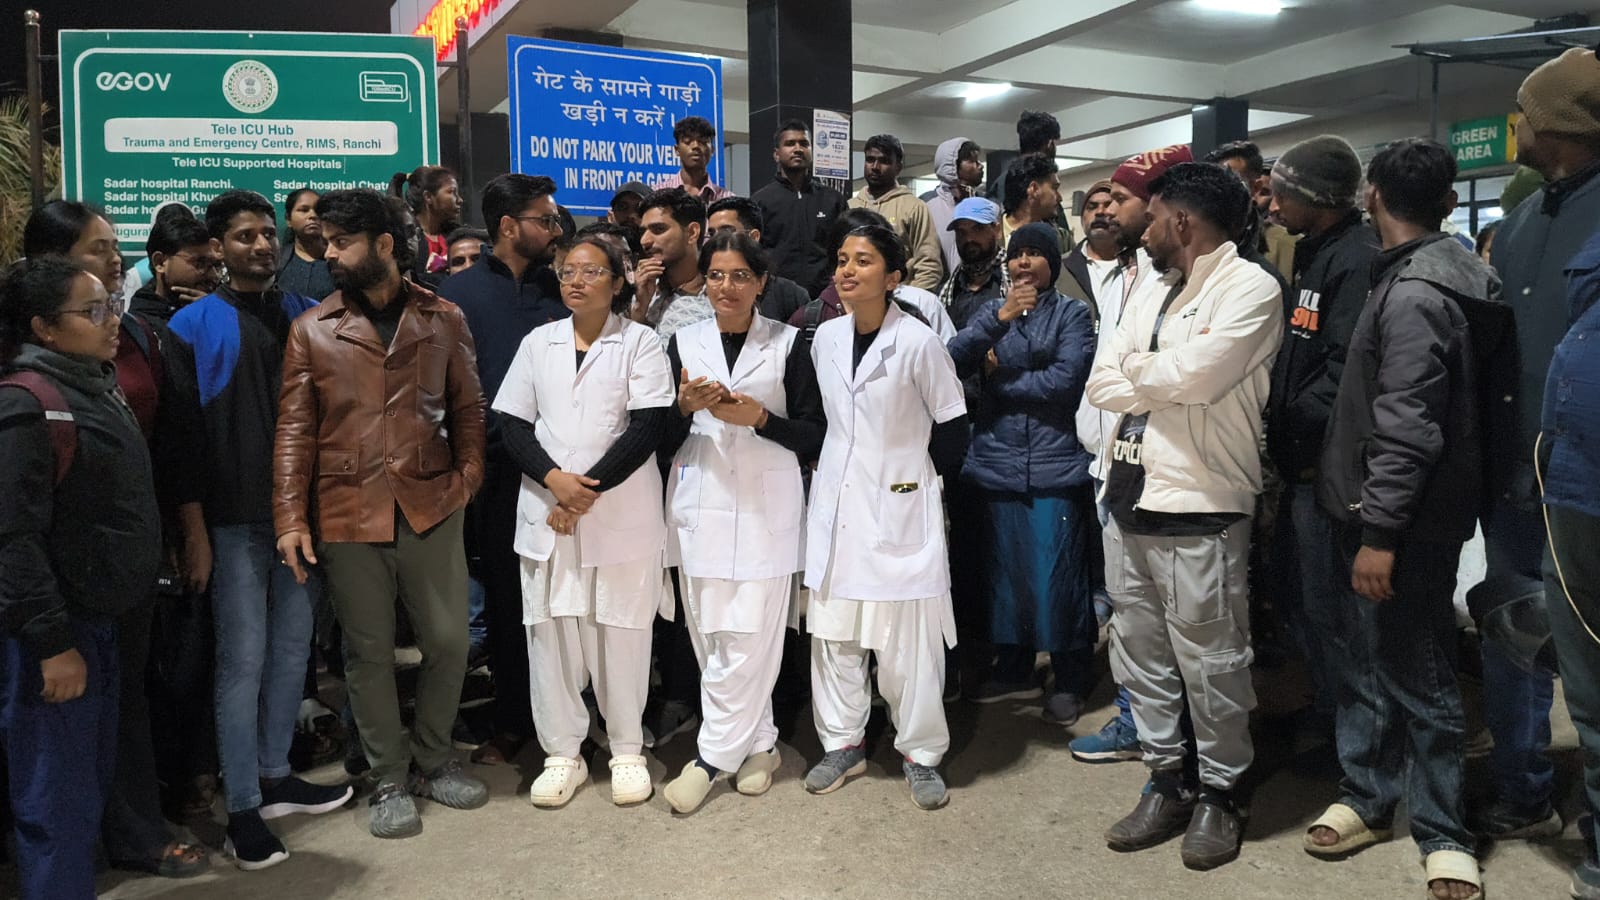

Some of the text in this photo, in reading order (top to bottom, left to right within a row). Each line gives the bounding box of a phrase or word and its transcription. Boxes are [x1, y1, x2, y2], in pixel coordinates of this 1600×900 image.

[532, 66, 702, 107] गेट के सामने गाड़ी
[560, 100, 607, 127] खड़ी
[612, 107, 628, 124] न
[632, 105, 665, 130] करें
[211, 124, 294, 136] Tele ICU Hub
[1451, 126, 1498, 145] GREEN
[123, 137, 382, 150] Trauma and Emergency Centre, RIMS, Ranchi
[530, 136, 681, 167] DO NOT PARK YOUR VEH
[1457, 144, 1492, 161] AREA
[172, 157, 342, 171] Tele ICU Supported Hospitals
[104, 178, 234, 191] Sadar hospital Ranchi.
[274, 180, 307, 190] Sadar
[310, 180, 356, 191] hospital
[565, 168, 578, 189] IN
[582, 169, 624, 191] FRONT
[104, 192, 138, 202] Sadar
[141, 192, 188, 203] hospital
[105, 205, 139, 215] Sadar
